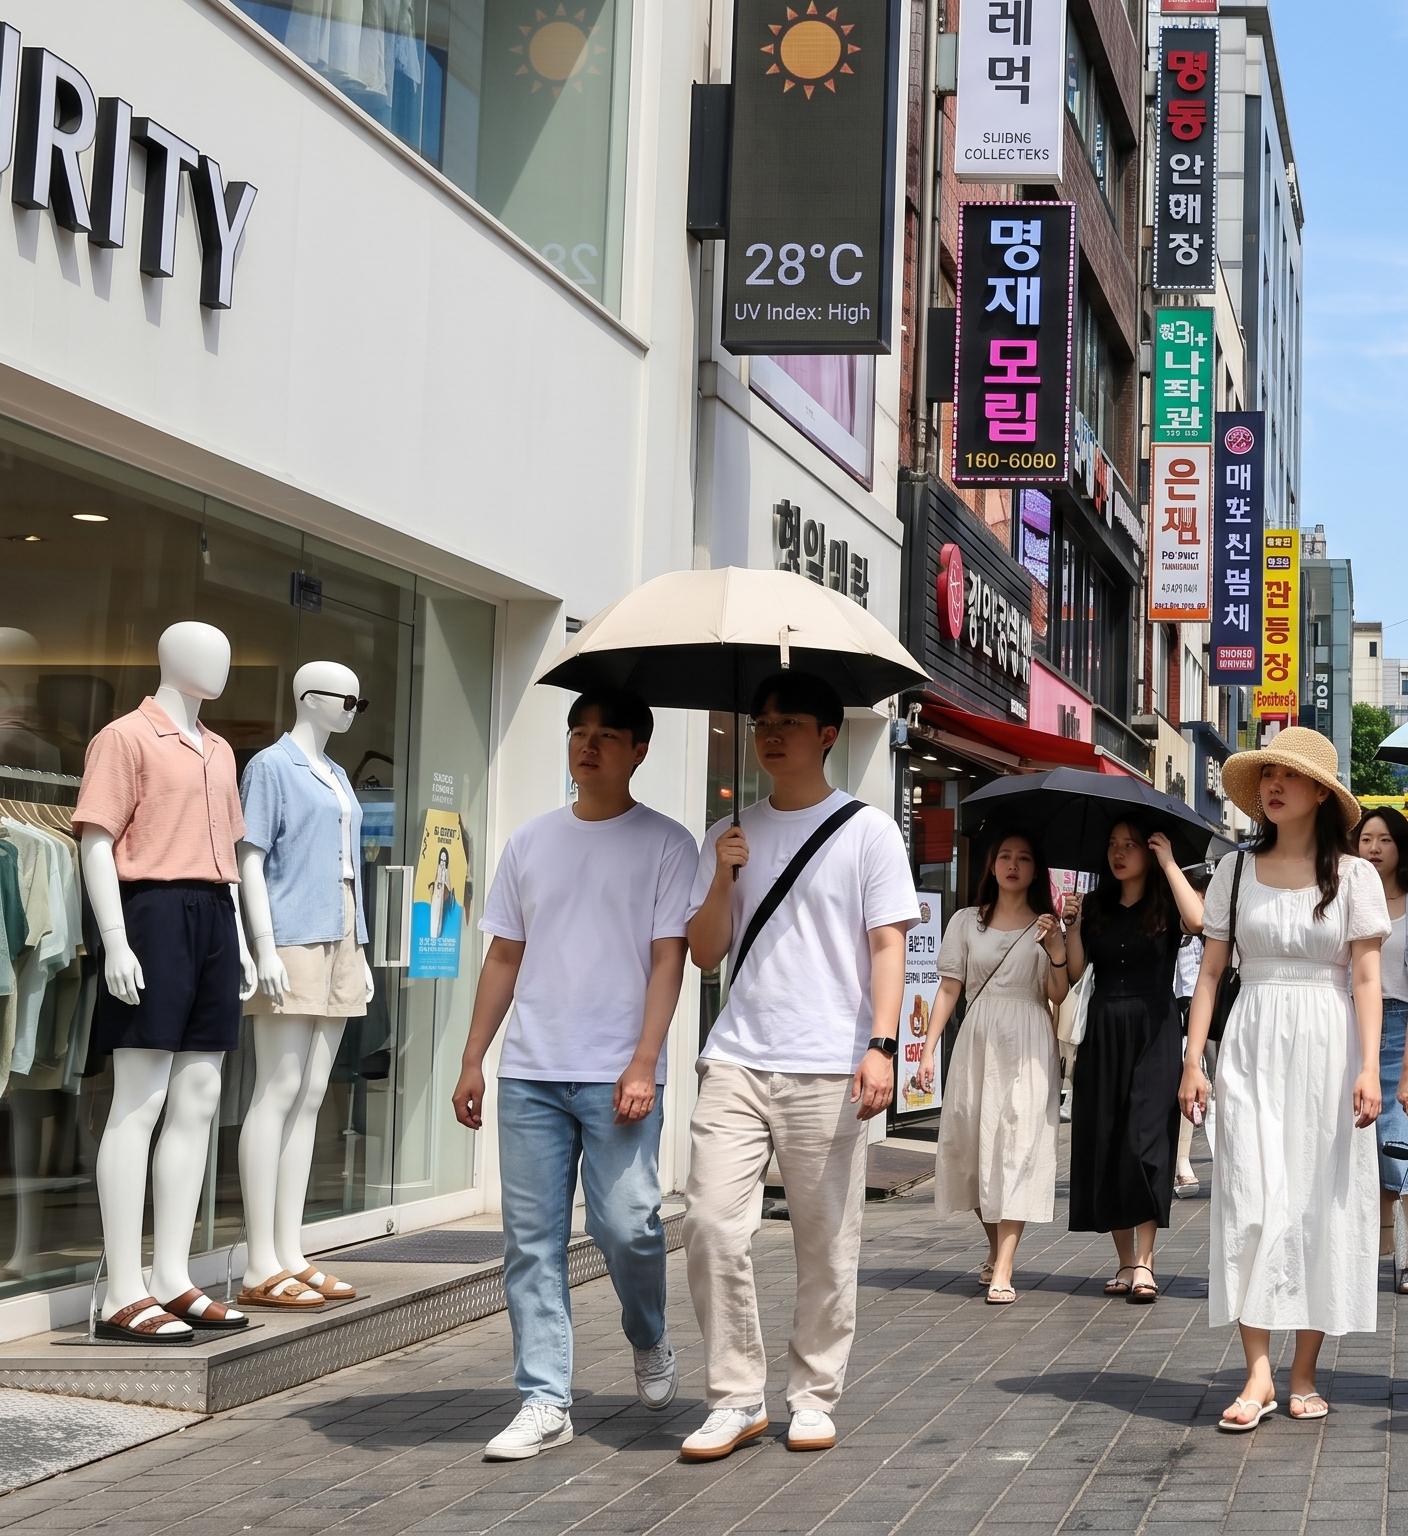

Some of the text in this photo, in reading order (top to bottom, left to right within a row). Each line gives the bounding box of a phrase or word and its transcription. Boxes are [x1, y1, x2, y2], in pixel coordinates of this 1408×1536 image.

[745, 242, 864, 286] 28°C
[735, 302, 871, 325] UV Index: High
